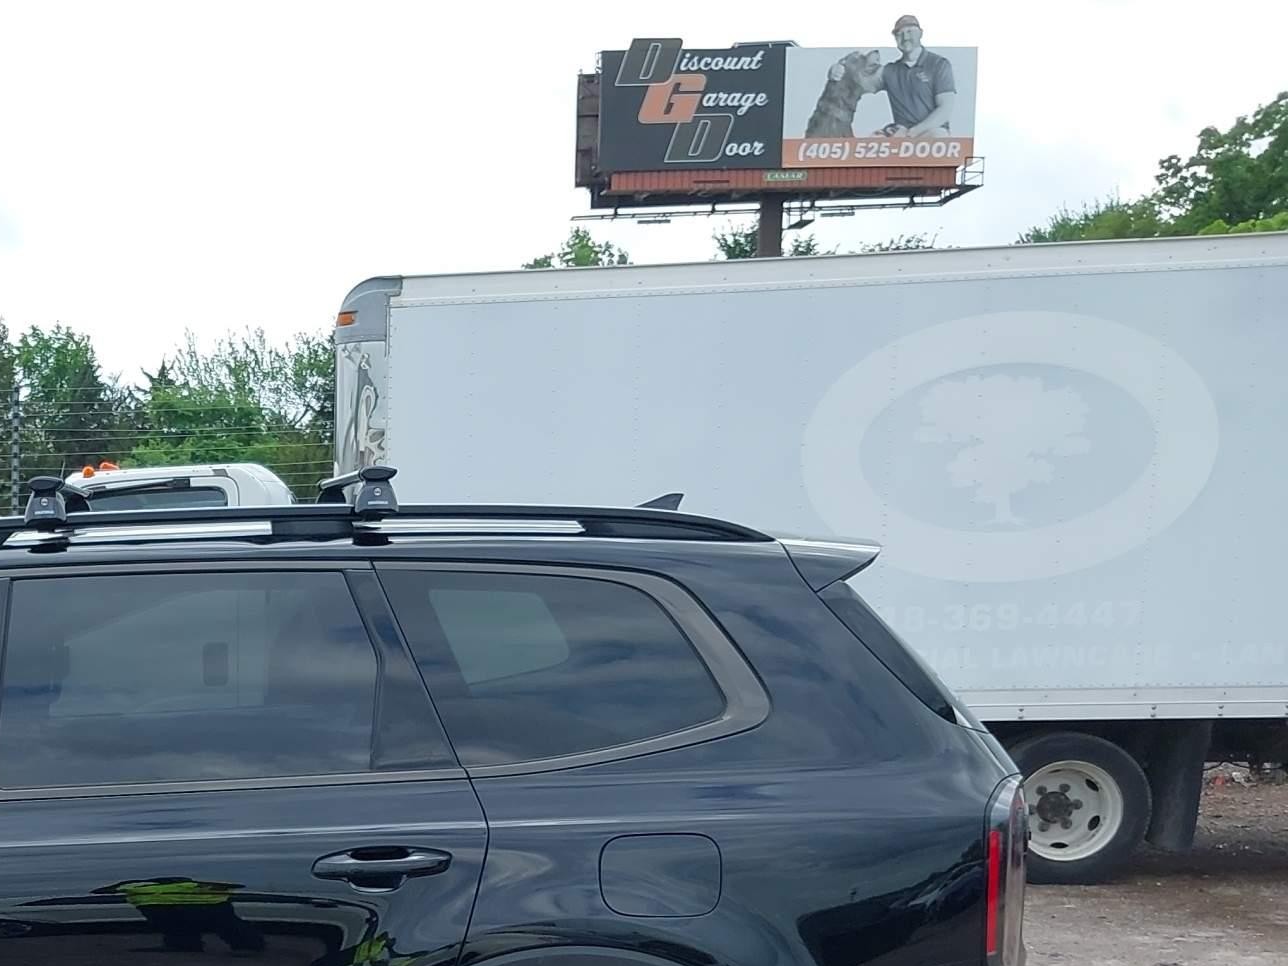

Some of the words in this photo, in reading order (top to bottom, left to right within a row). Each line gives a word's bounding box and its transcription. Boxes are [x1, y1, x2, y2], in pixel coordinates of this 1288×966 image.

[615, 38, 764, 86] Discount
[638, 74, 768, 124] Garage
[664, 113, 764, 163] Door
[798, 142, 850, 161] (405)
[855, 141, 961, 159] 525-DOOR
